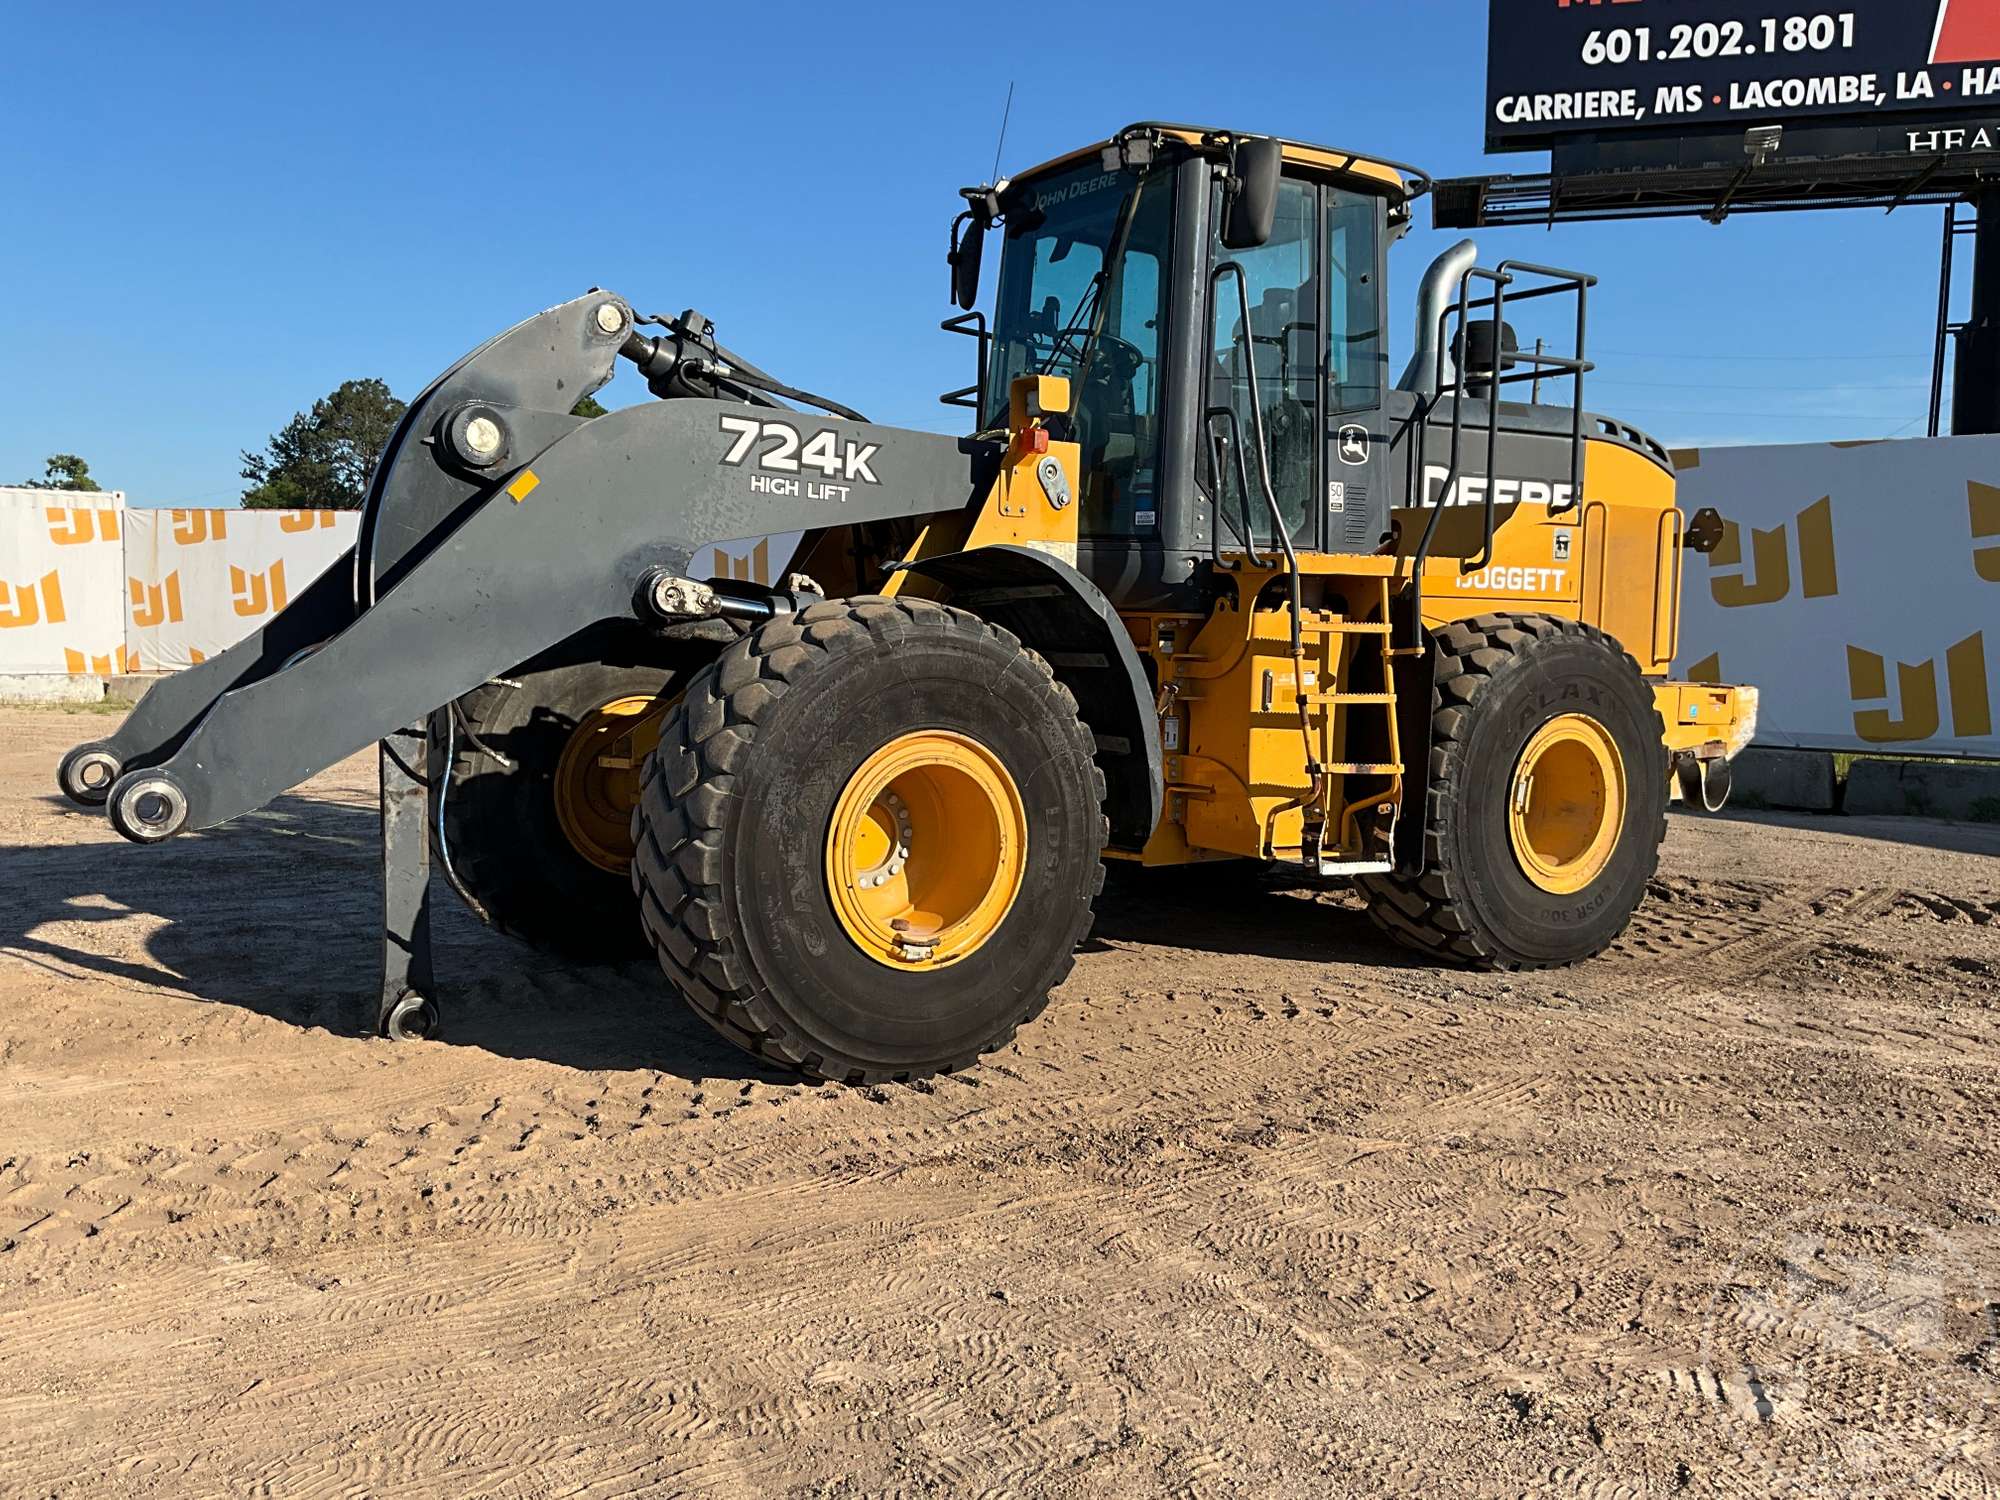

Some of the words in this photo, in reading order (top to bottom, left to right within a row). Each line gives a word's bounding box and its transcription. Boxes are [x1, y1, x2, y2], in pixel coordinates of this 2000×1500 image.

[1581, 13, 1854, 65] 601.202.1801
[1495, 89, 1645, 123] CARRIERE,
[1654, 84, 1703, 115] MS
[1729, 74, 1886, 109] LACOMBE,
[1896, 71, 1934, 99] LA
[1030, 187, 1069, 211] JOHN
[1068, 171, 1119, 199] DEERE
[720, 414, 881, 484] 724K
[750, 475, 800, 497] HIGH
[807, 482, 850, 502] LIFT
